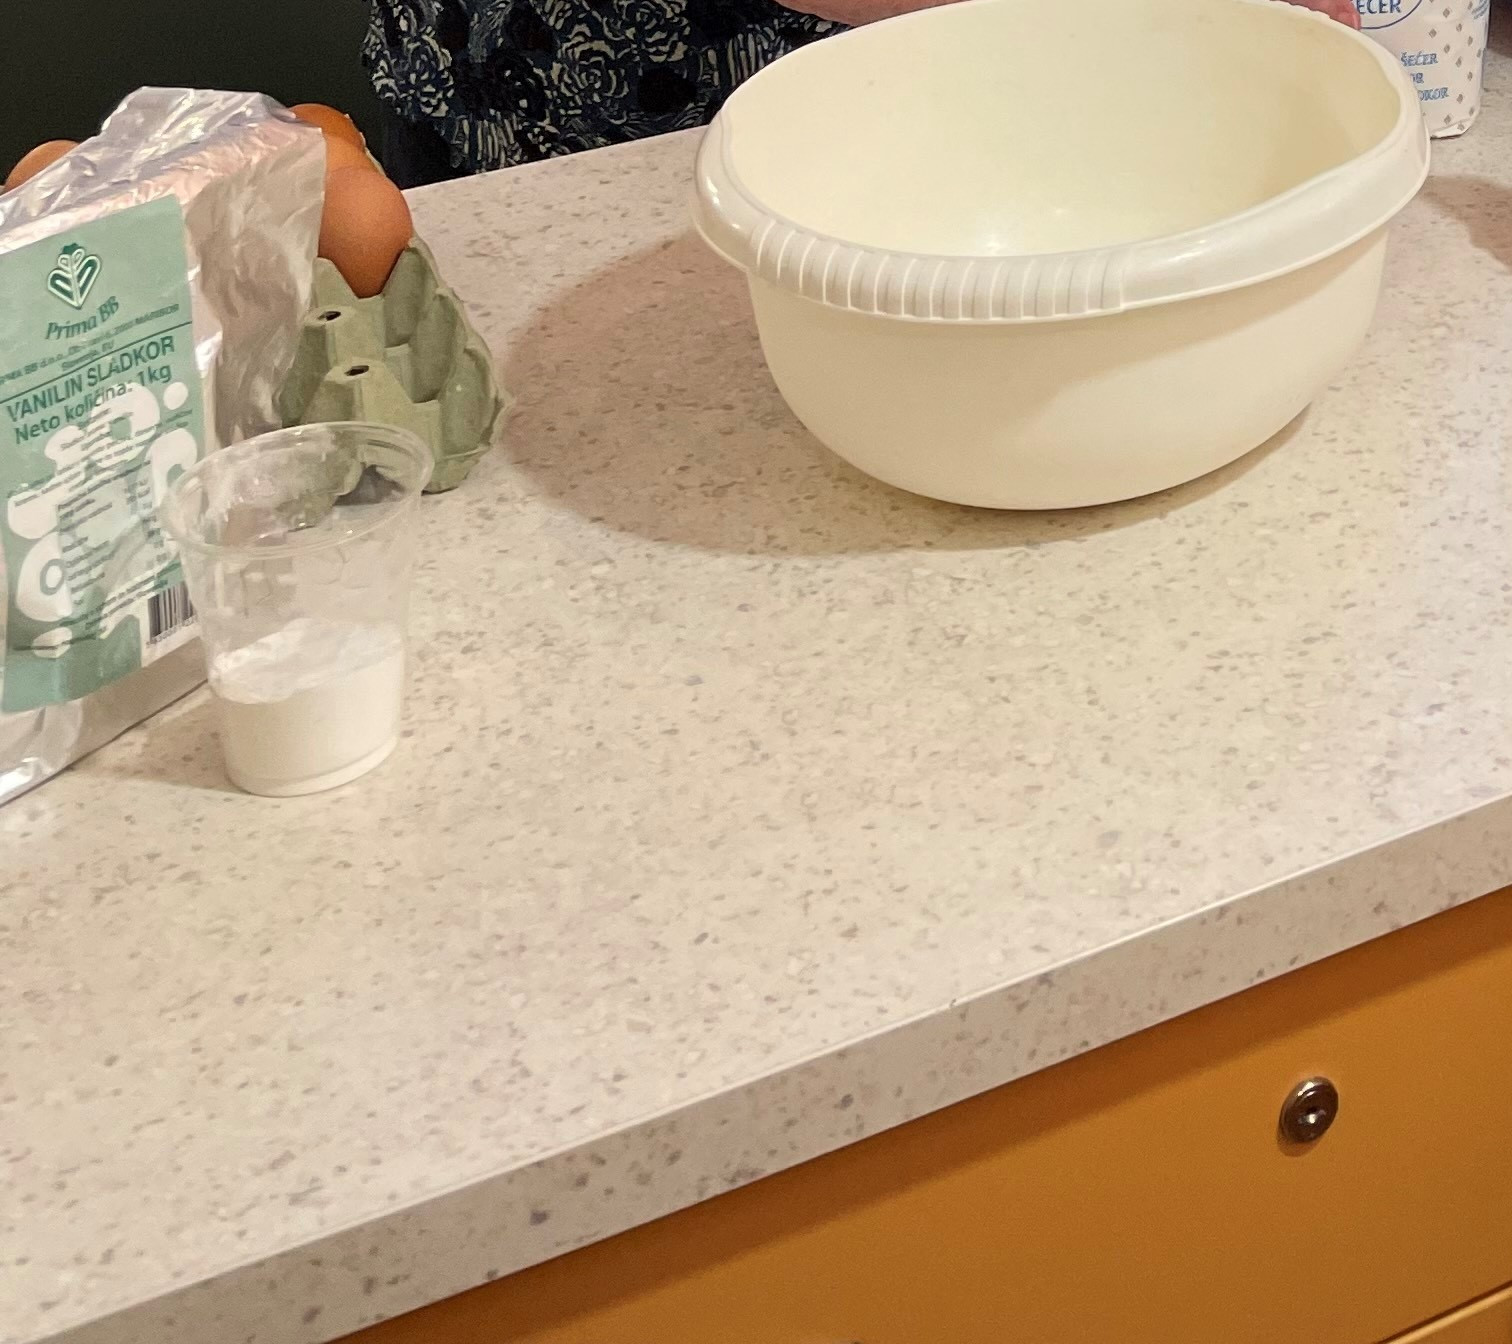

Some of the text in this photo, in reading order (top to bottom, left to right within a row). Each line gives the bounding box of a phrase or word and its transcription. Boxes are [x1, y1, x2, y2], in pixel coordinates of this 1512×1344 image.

[45, 315, 97, 340] Prima
[6, 374, 83, 422] VANILIN
[87, 335, 175, 387] SLADKOR
[15, 415, 61, 444] Neto
